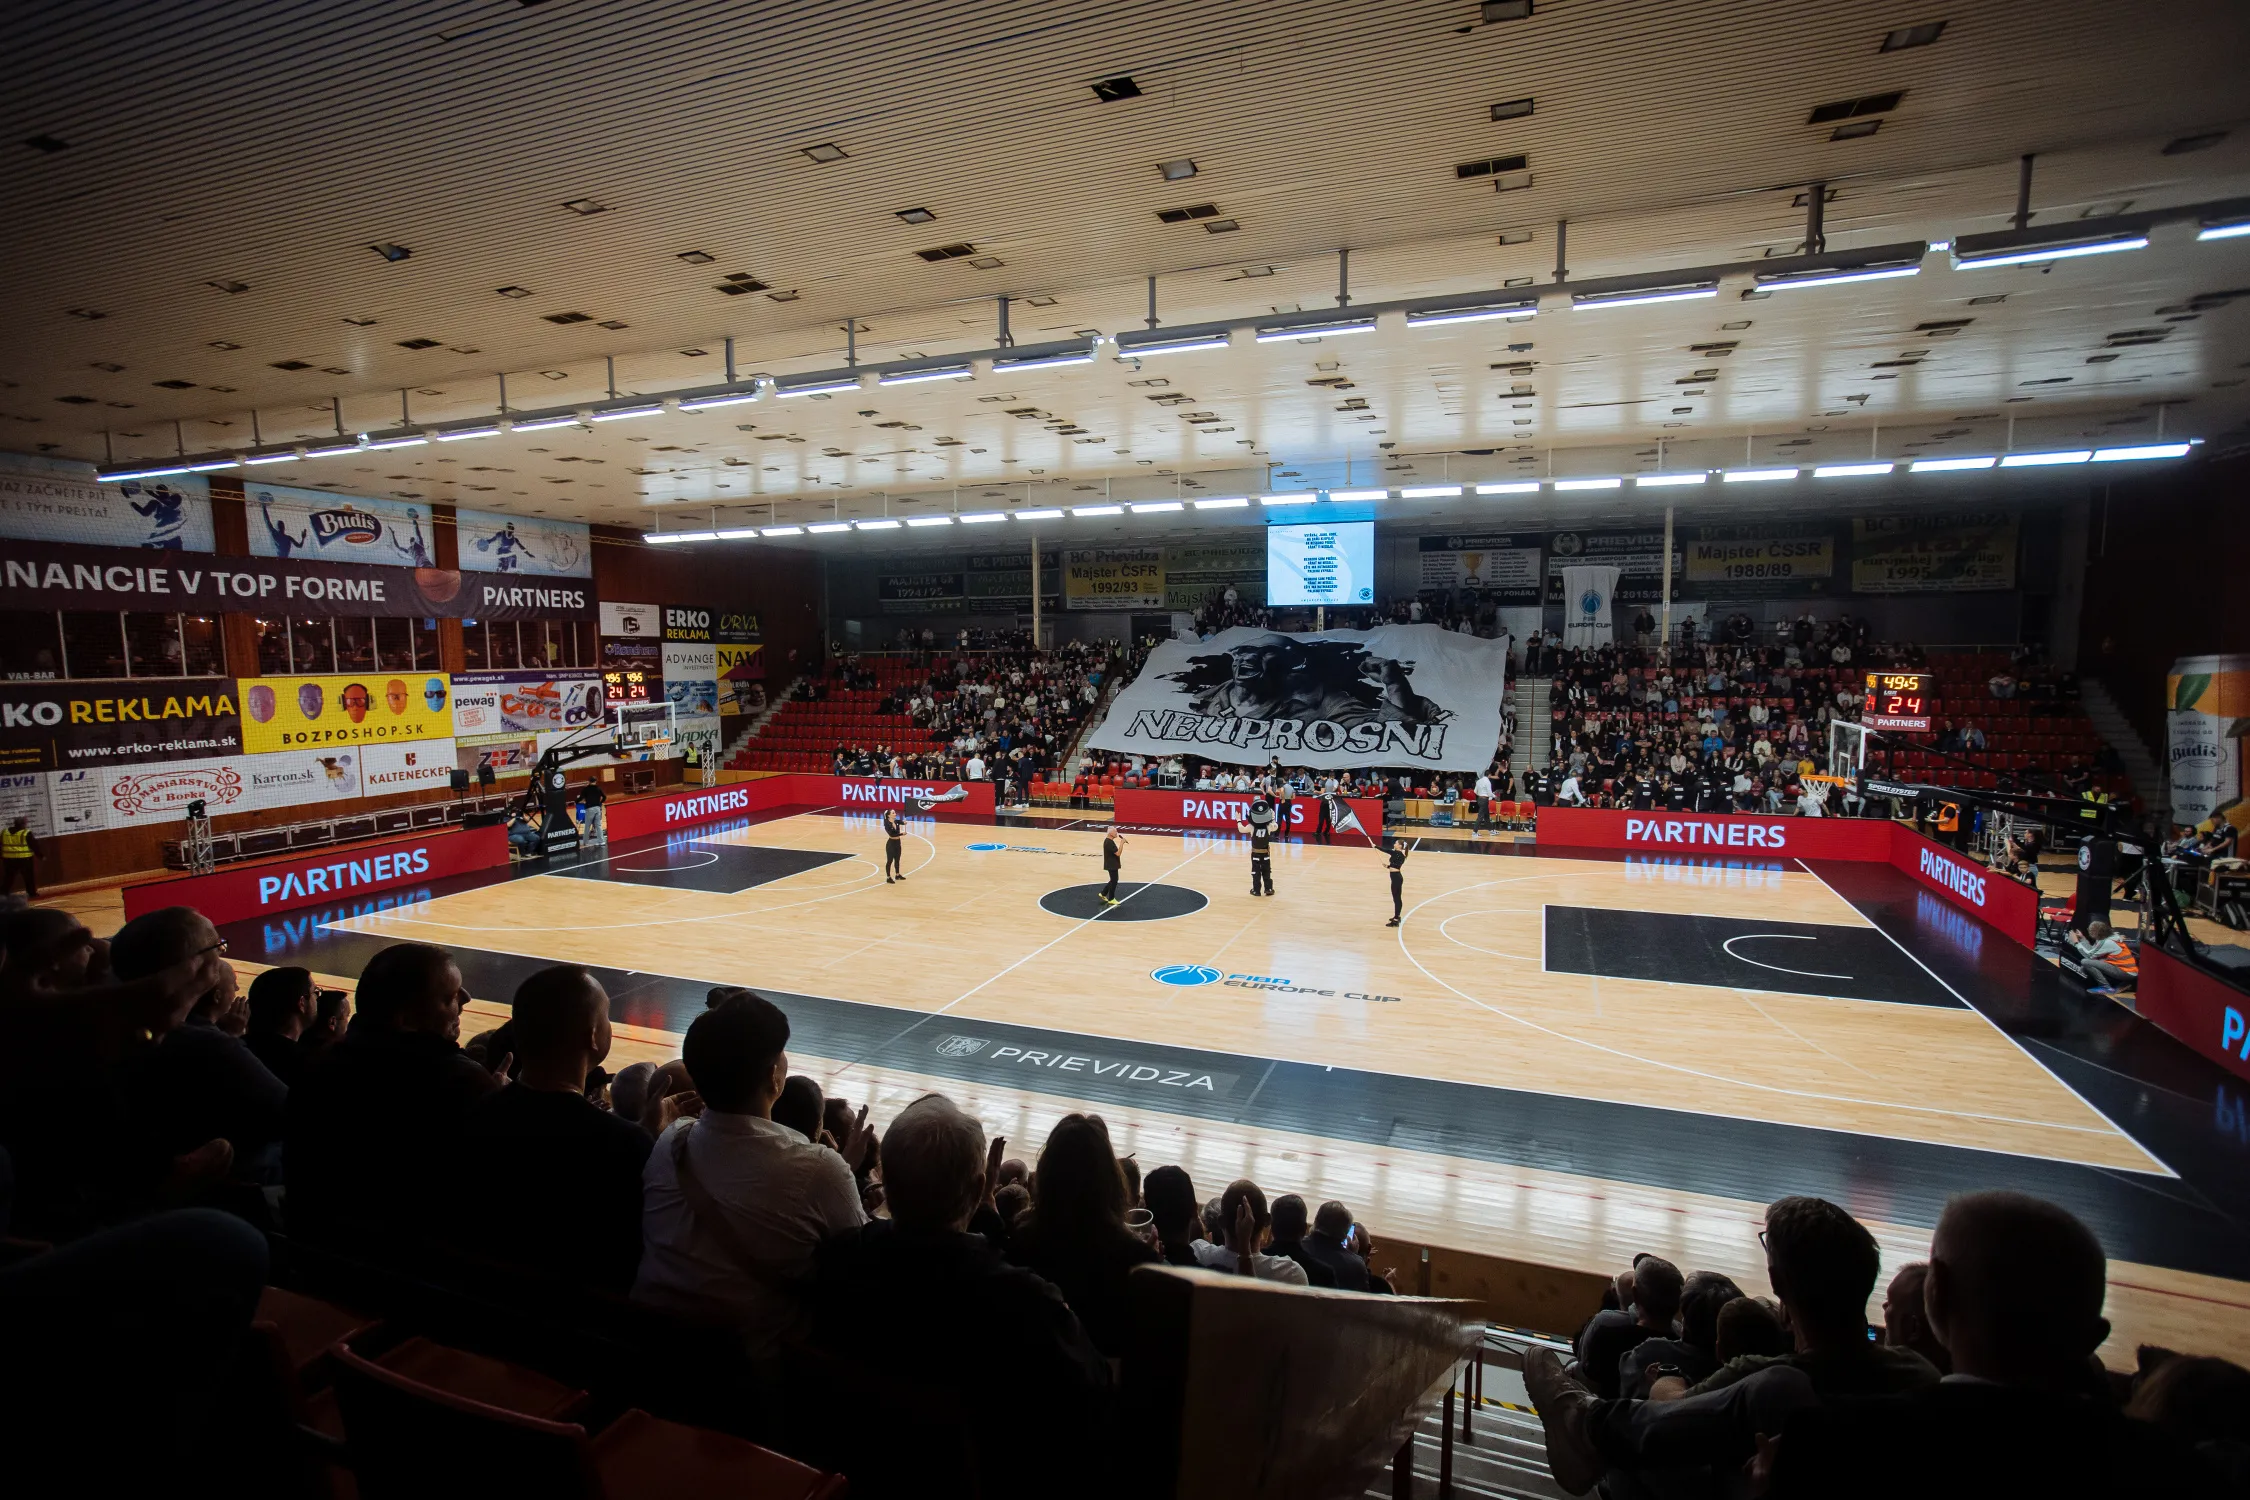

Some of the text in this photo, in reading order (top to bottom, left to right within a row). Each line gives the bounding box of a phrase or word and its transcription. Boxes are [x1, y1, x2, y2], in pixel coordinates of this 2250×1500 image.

[319, 513, 375, 537] Budiš
[1096, 549, 1160, 567] Prievidza
[1697, 541, 1822, 562] Majster ČSSR
[1072, 566, 1118, 583] Majster
[1121, 563, 1159, 580] ČSFR
[1725, 563, 1792, 578] 1988/89
[0, 561, 386, 602] NANCIE V TOP FORME
[1091, 582, 1139, 598] 1992/93
[483, 586, 585, 609] PARTNERS
[666, 609, 710, 629] ERKO
[667, 629, 711, 641] REKLAMA
[666, 653, 714, 664] ADVANCE
[718, 650, 763, 669] NAVI
[8, 671, 56, 681] VAR-BAR
[609, 685, 623, 698] 24
[631, 685, 646, 698] 24
[0, 695, 237, 728] KO REKLAMA
[455, 696, 495, 710] pewag
[1888, 696, 1920, 713] 24
[1877, 718, 1926, 730] PARTNERS
[282, 724, 424, 745] BOZPOSHOP.SK
[68, 735, 237, 758] www.erko-reklama.sk
[60, 771, 86, 782] AJ
[253, 769, 315, 785] Karton.sk
[369, 766, 452, 785] KALTENECKER
[664, 788, 749, 822] PARTNERS
[2189, 803, 2209, 812] 12%
[547, 828, 576, 839] PARTNERS
[1256, 828, 1267, 838] 47
[1625, 818, 1786, 848] PARTNERS
[259, 848, 430, 904] PARTNERS
[1921, 846, 1986, 908] PARTNERS
[1228, 973, 1291, 985] FIBA
[1223, 980, 1402, 1003] EUROPE CUP
[990, 1046, 1215, 1091] PRIEVIDZA
